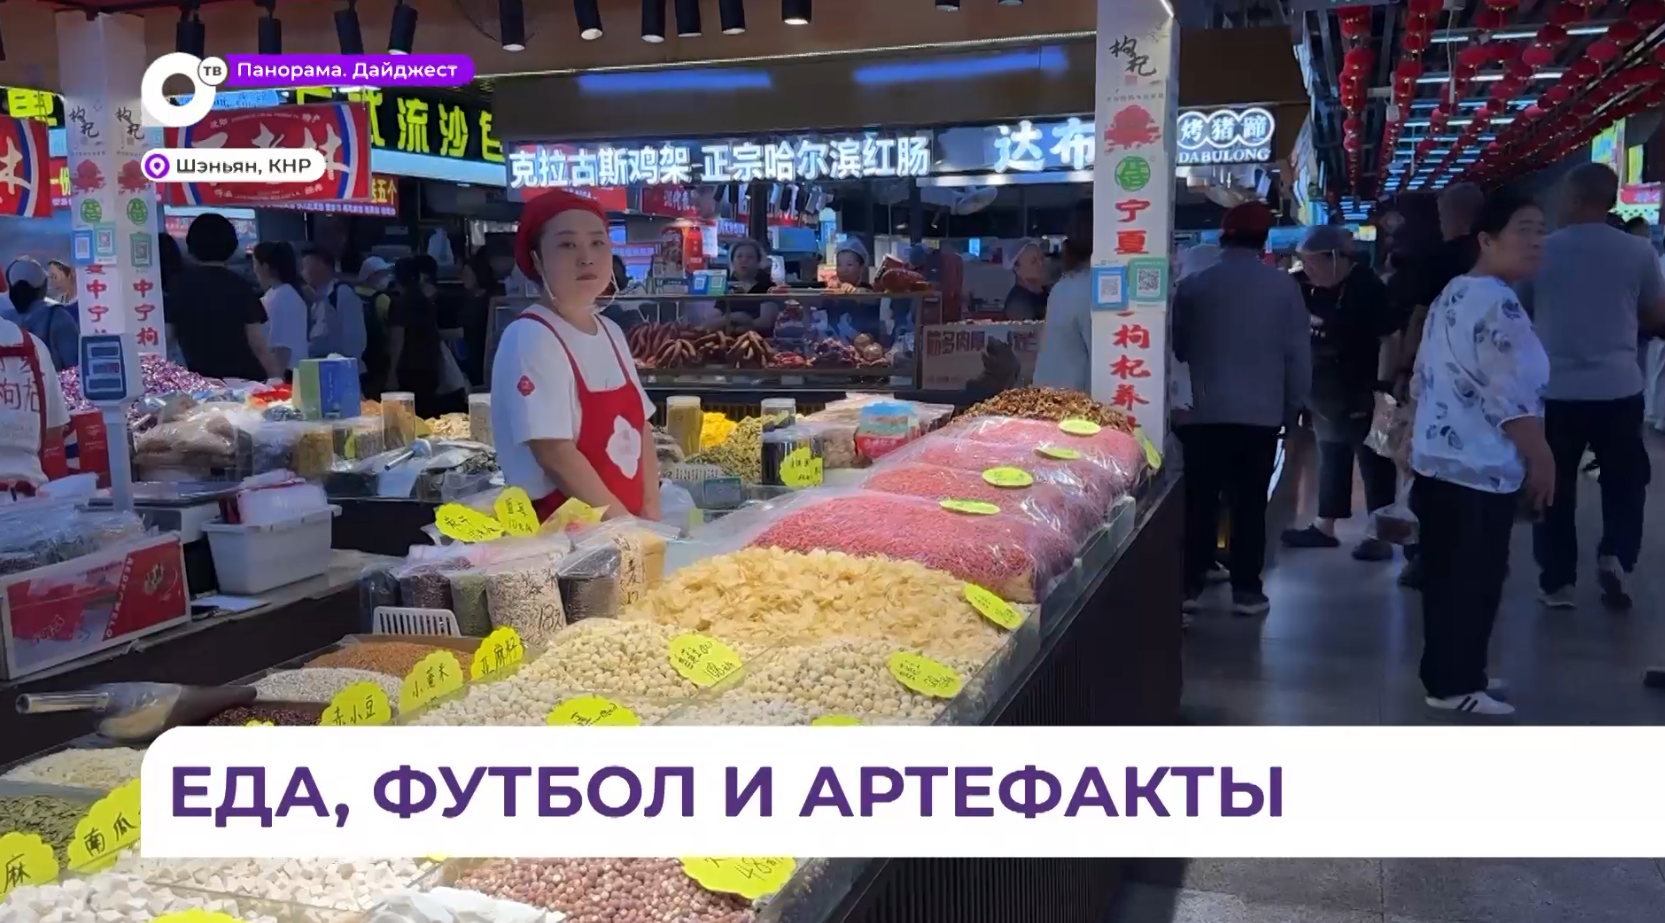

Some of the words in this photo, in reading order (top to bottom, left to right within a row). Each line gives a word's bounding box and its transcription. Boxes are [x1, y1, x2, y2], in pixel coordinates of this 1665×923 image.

[1181, 114, 1268, 141] 烤猪蹄
[1179, 148, 1271, 163] DABULONG
